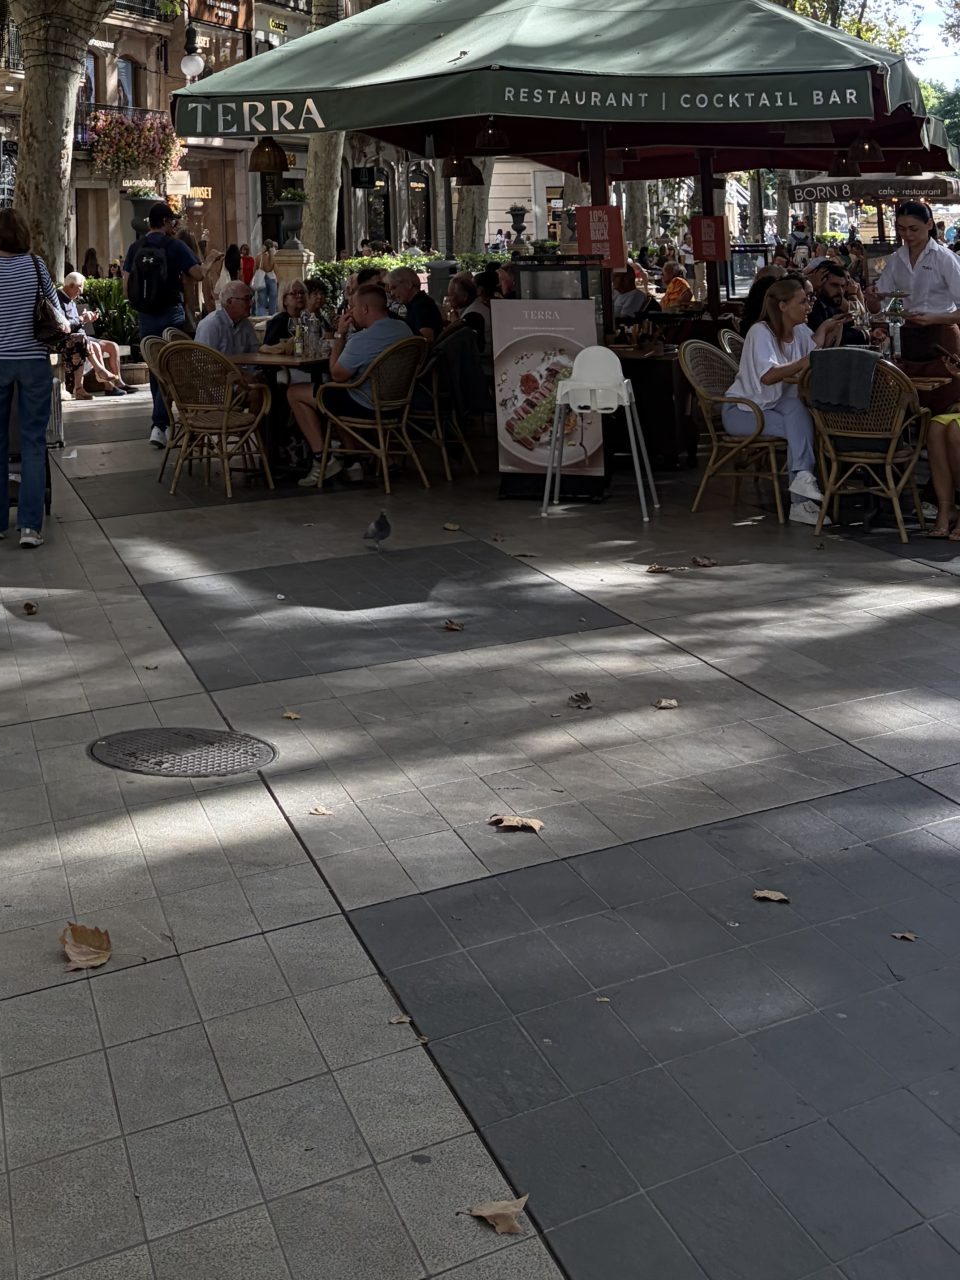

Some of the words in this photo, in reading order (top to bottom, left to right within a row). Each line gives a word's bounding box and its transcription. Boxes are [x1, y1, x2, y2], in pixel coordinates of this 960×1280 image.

[504, 87, 649, 108] RESTAURANT
[680, 91, 799, 108] COCKTAIL
[812, 88, 858, 105] BAR
[187, 97, 326, 133] TERRA
[794, 185, 838, 201] BORN
[841, 183, 851, 197] 8
[902, 185, 942, 196] restaurant
[589, 210, 608, 221] 10%
[522, 310, 561, 320] TERRA
